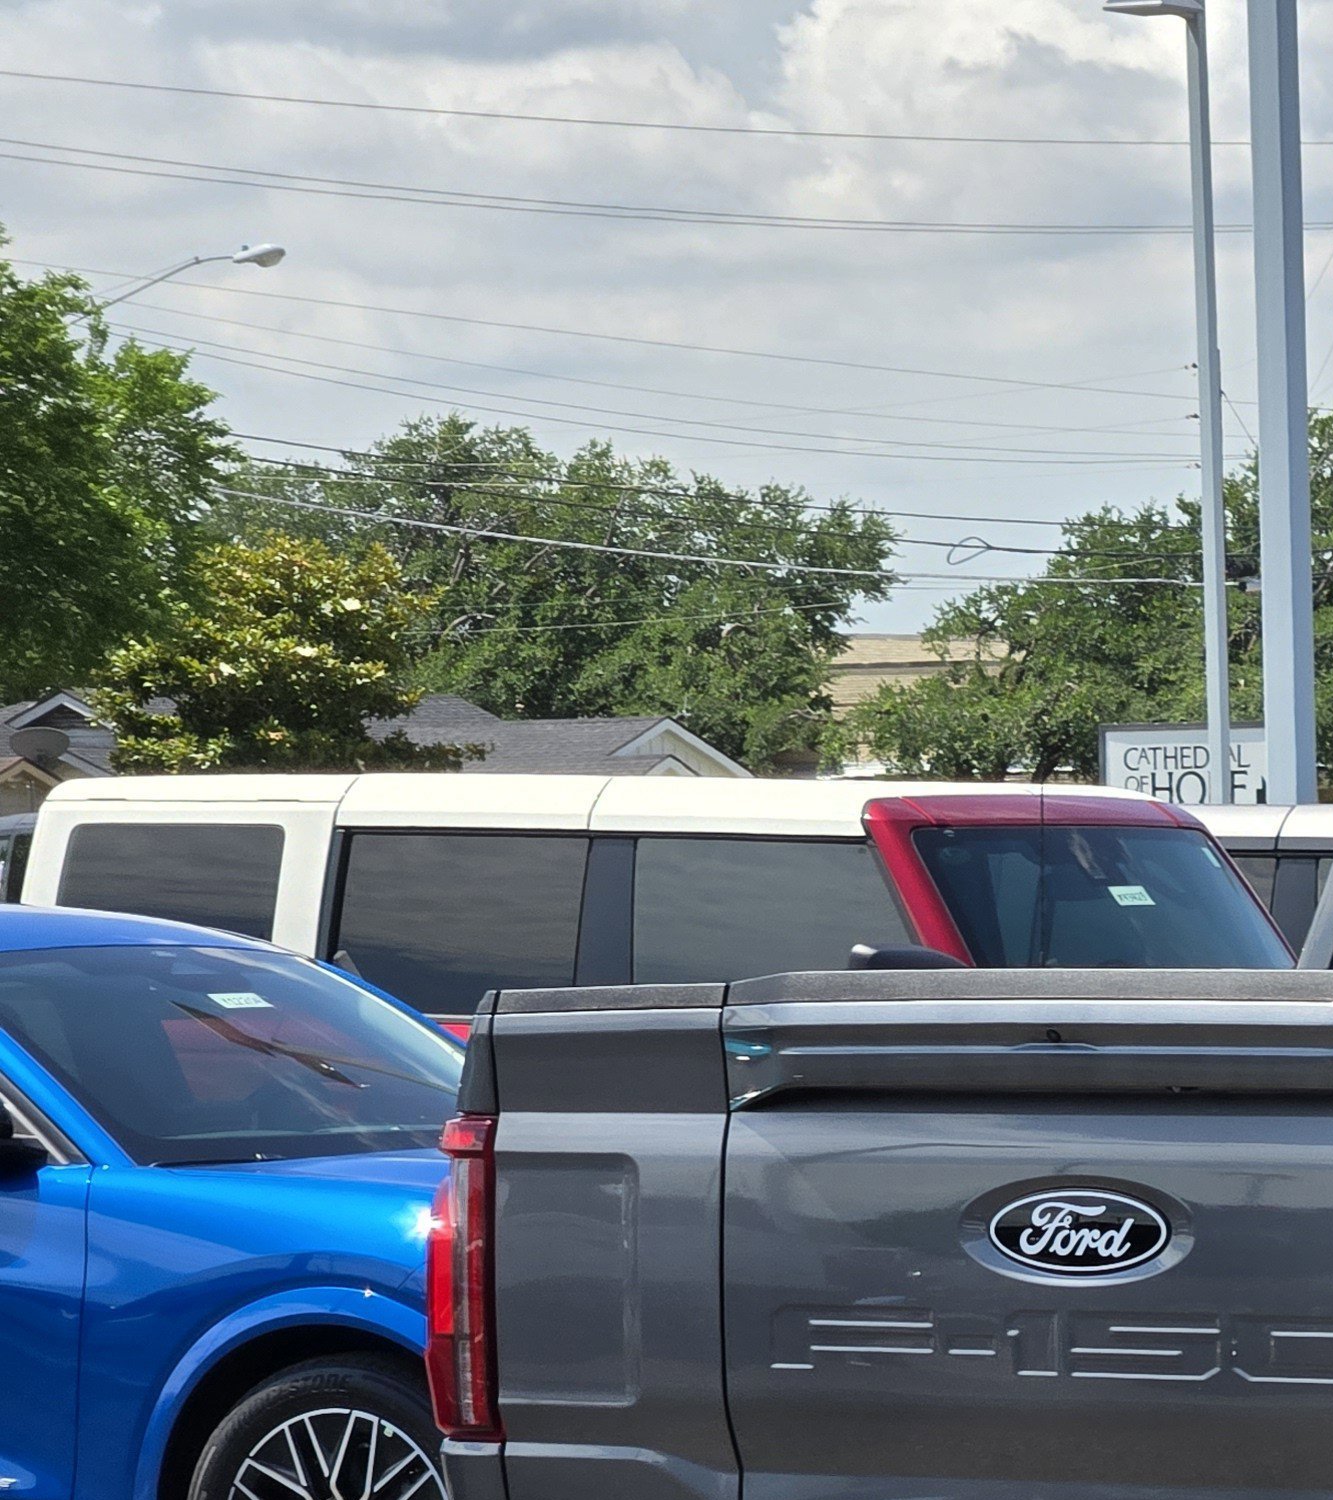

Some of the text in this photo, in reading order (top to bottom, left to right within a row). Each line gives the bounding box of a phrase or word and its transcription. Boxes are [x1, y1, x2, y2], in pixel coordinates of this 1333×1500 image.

[1123, 744, 1251, 771] CATHEDAL
[1125, 770, 1248, 804] OF HOE
[1020, 1201, 1134, 1258] Ford
